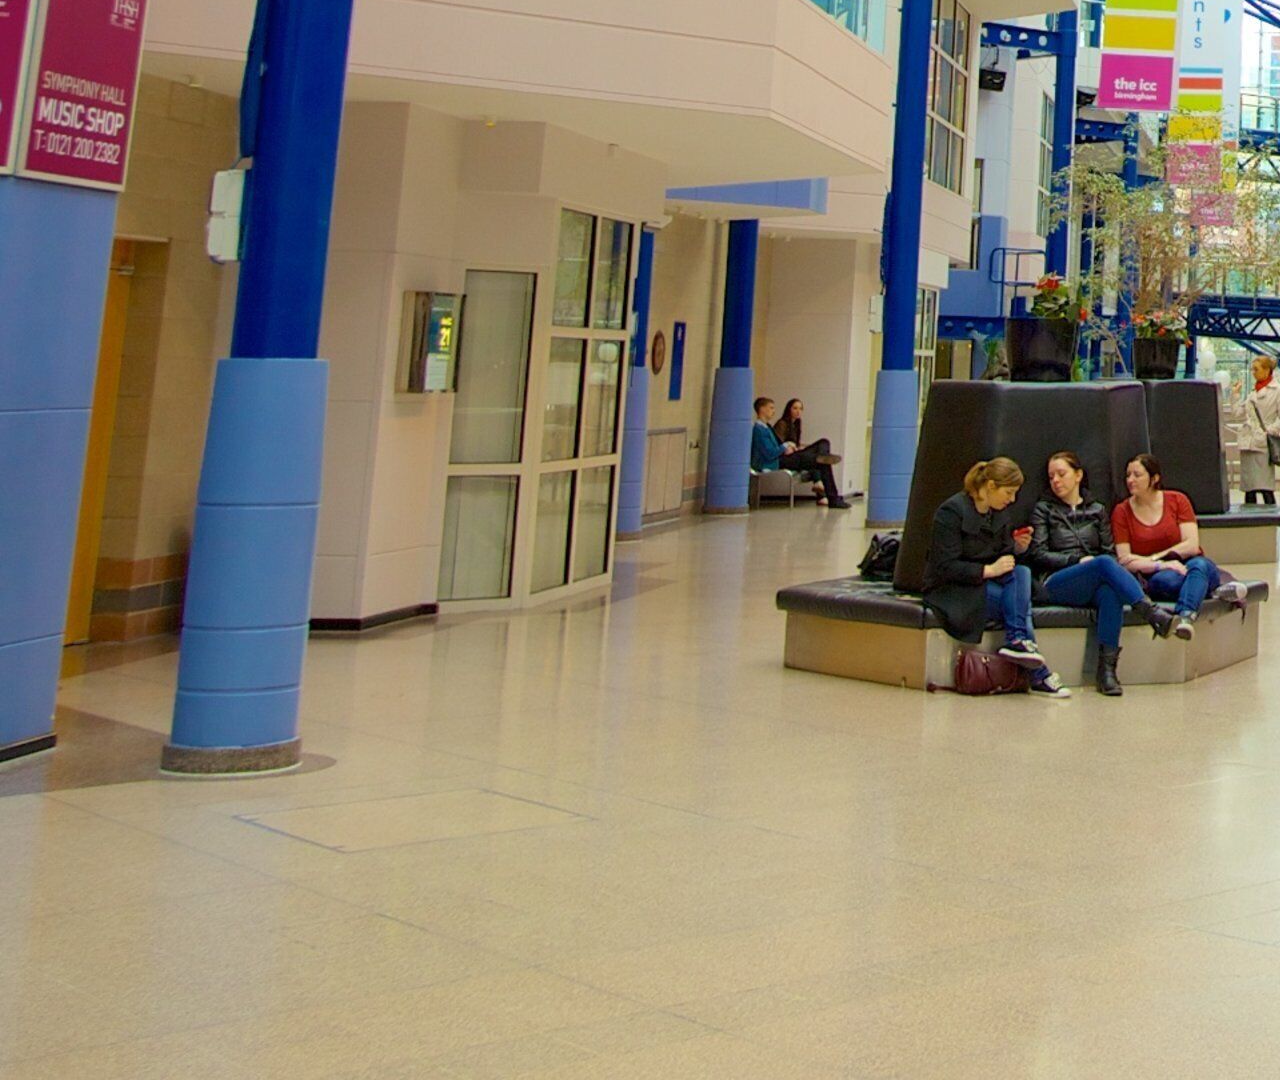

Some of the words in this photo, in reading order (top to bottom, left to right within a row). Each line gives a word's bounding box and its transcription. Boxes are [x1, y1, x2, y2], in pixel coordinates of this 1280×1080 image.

[42, 70, 100, 98] SYMPHONY
[101, 85, 127, 107] HALL
[1114, 77, 1137, 92] the
[1139, 78, 1158, 93] icc
[1114, 91, 1157, 103] birmingham
[38, 95, 85, 130] MUSIC
[84, 107, 125, 137] SHOP
[72, 136, 94, 160] 200
[93, 141, 120, 165] 2382
